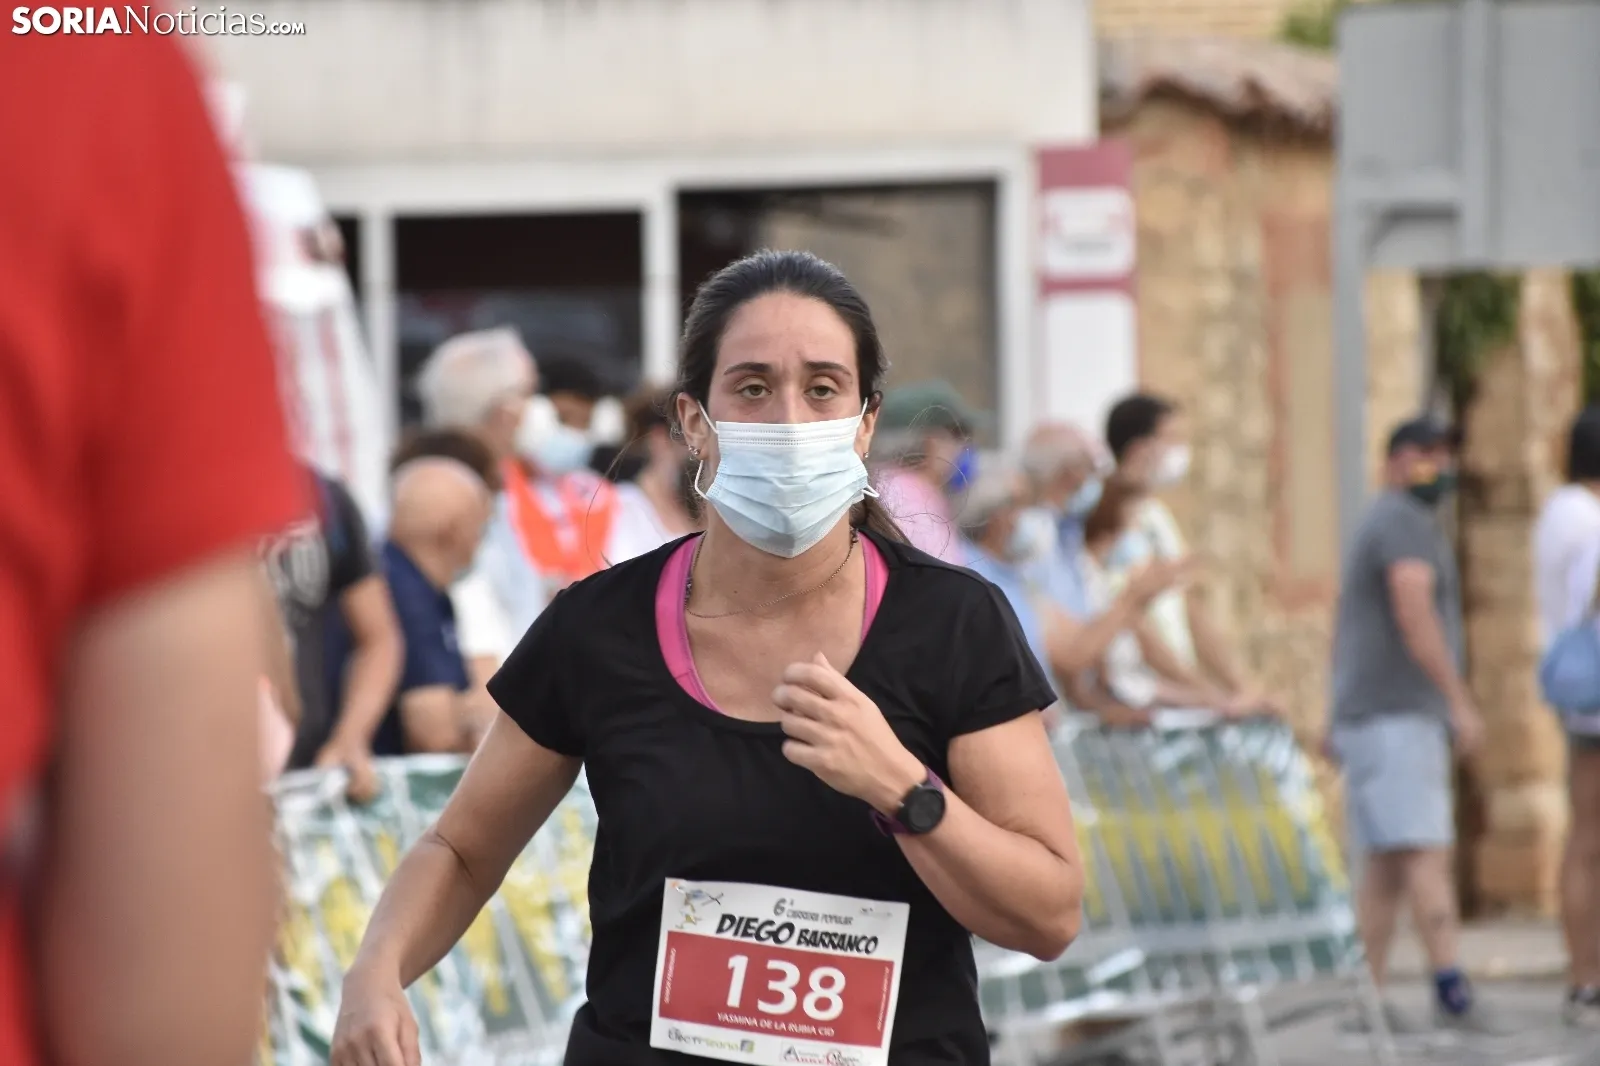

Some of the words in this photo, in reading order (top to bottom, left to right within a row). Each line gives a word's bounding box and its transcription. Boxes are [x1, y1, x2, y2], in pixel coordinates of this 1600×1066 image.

[716, 913, 796, 945] DIEGO
[796, 928, 879, 955] BARRANCO
[727, 954, 847, 1022] 138
[717, 1012, 759, 1027] YASMINA
[760, 1019, 774, 1030] DE
[774, 1022, 787, 1032] LA
